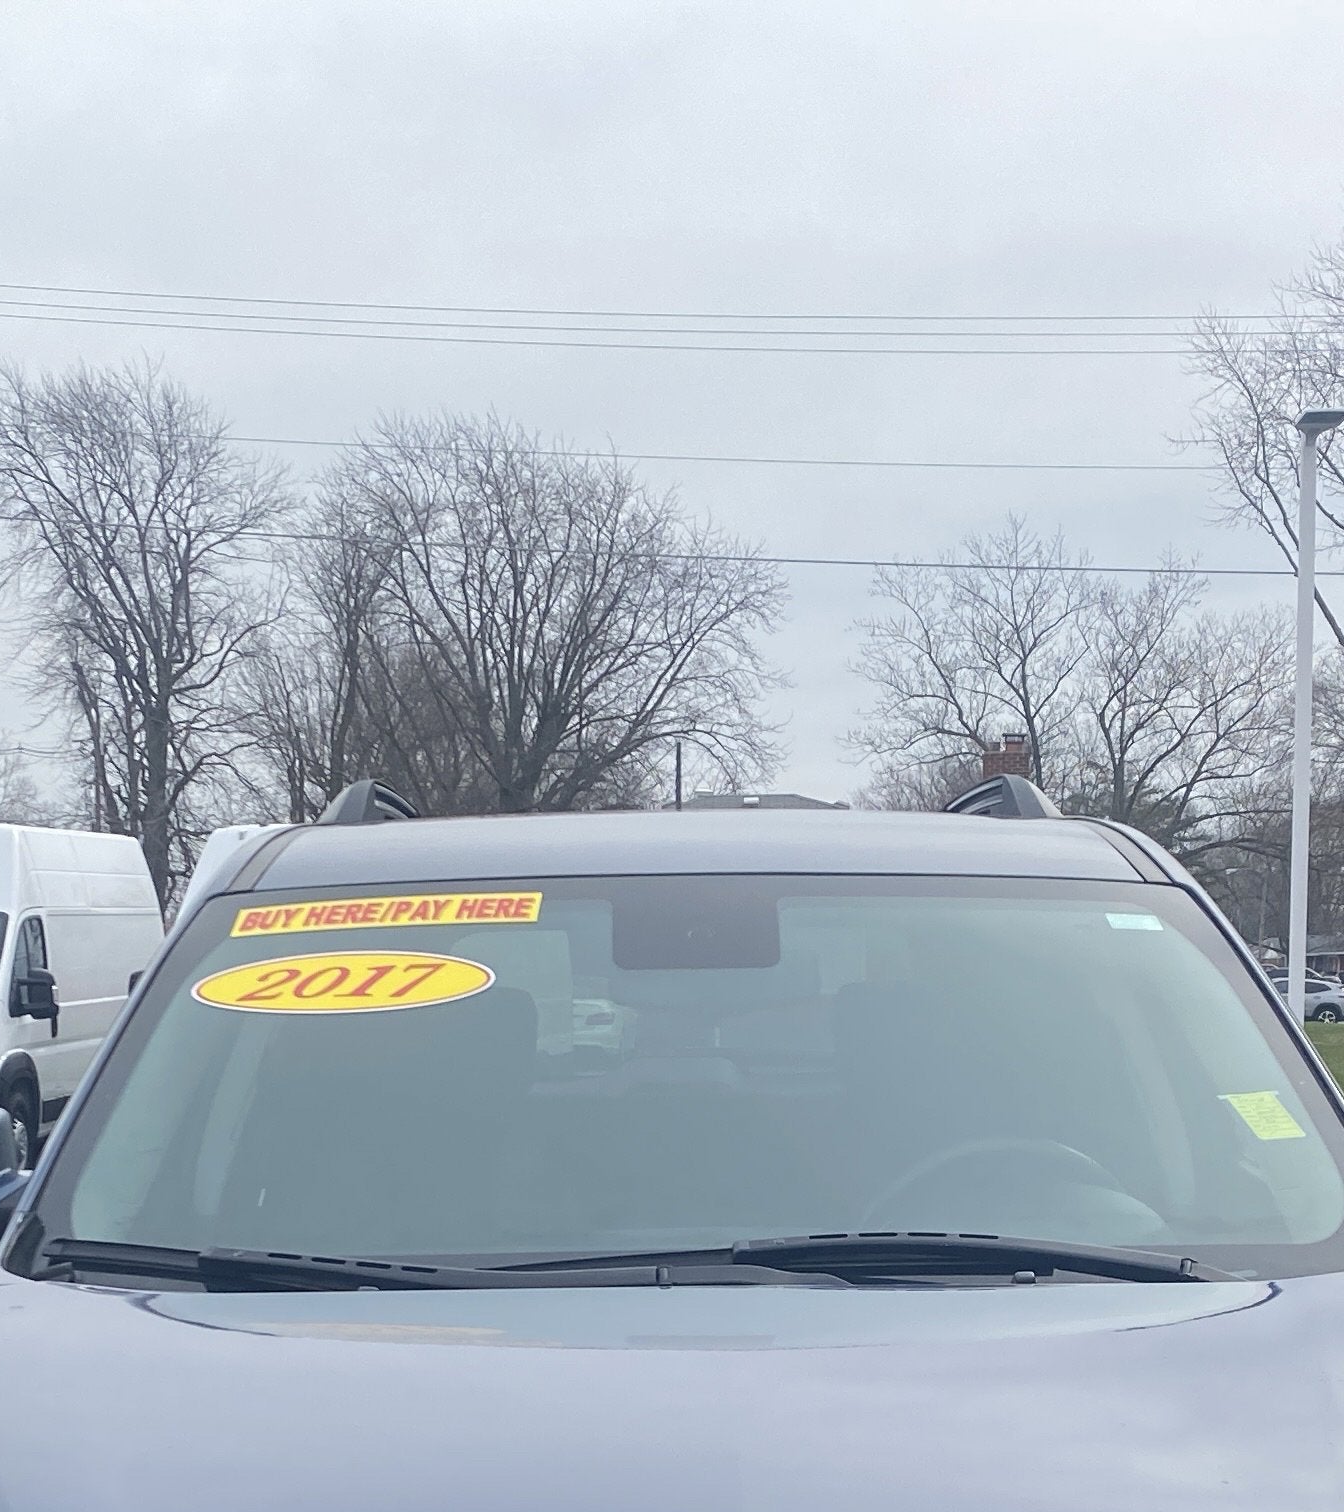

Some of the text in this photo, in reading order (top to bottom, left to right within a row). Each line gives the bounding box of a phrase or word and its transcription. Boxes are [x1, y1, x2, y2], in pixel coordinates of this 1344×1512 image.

[239, 898, 536, 931] BUY HERE/PAY HERE
[235, 962, 447, 1001] 2017
